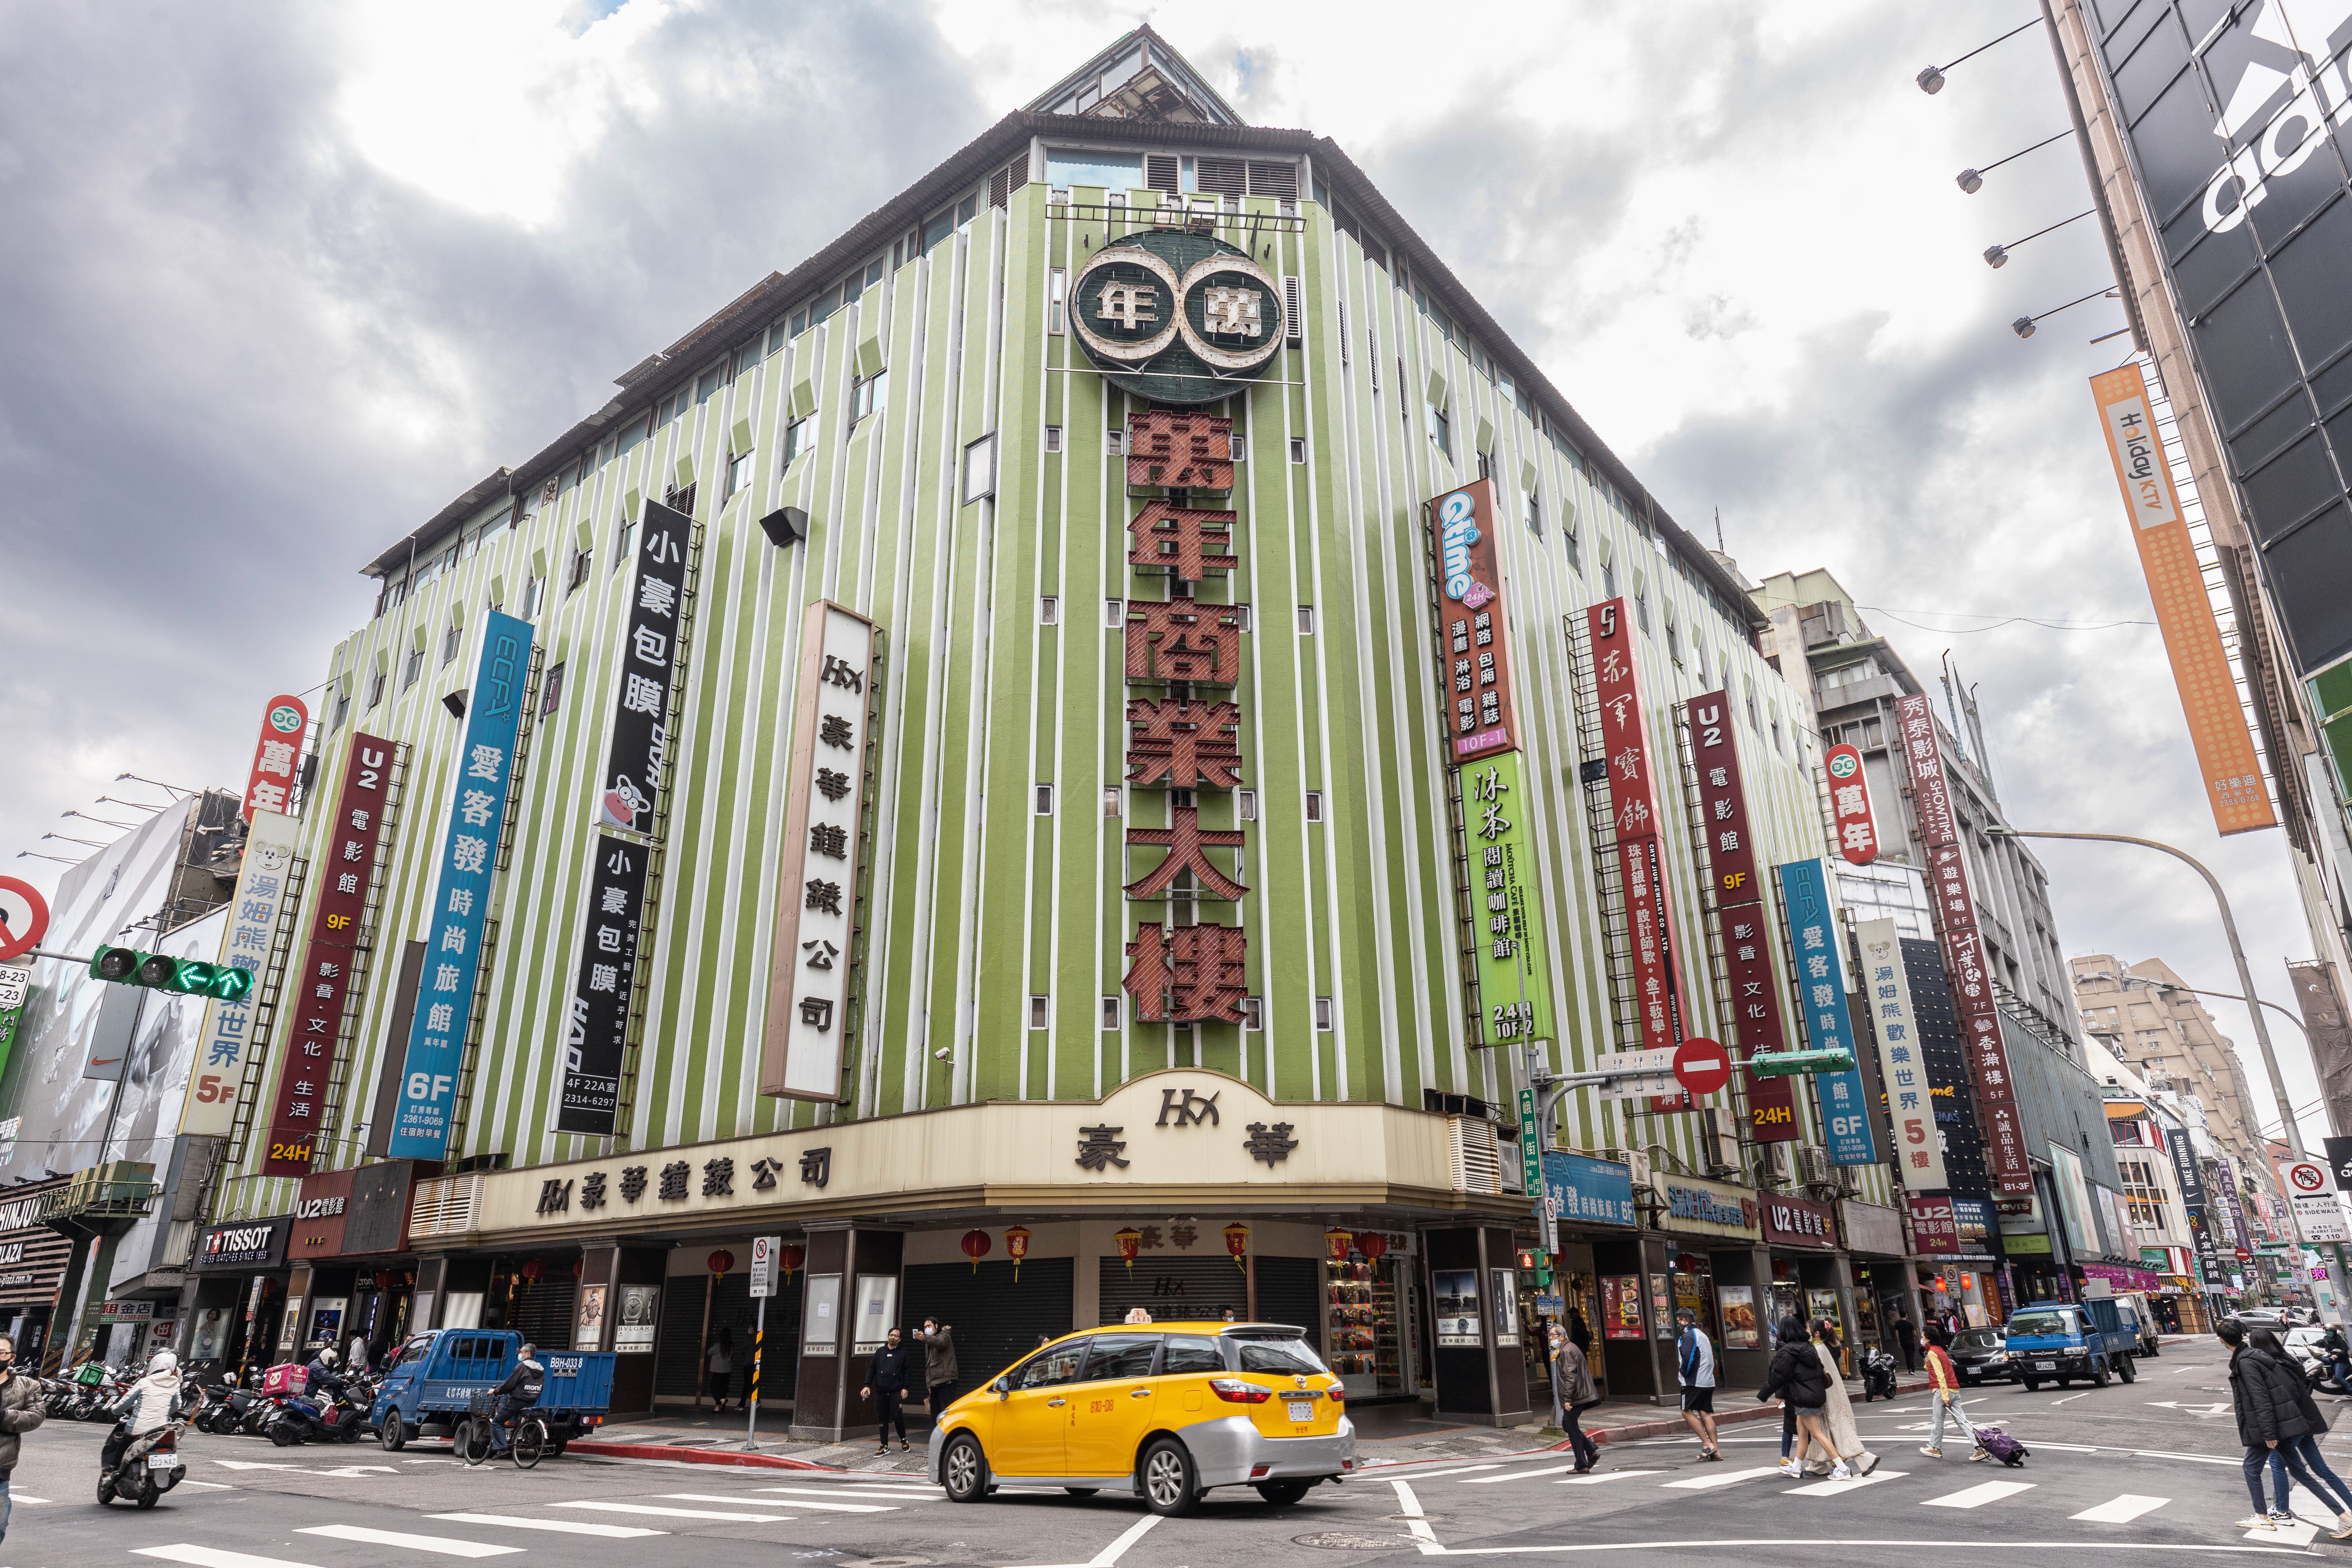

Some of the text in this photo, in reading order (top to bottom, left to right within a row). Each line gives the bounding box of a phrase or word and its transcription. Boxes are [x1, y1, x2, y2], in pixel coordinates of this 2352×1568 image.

[2120, 413, 2163, 510] Holiday KTV
[1466, 591, 1484, 602] 24H
[623, 529, 680, 719] 小豪包膜
[1451, 620, 1475, 732] 漫畫 淋浴 電影
[1475, 612, 1499, 725] 網路 包廂 雜誌
[1122, 410, 1250, 1025] 萬年商業大樓
[1698, 705, 1723, 748] U2
[1462, 731, 1502, 752] 10F-1
[1903, 697, 1939, 780] 秀泰影城
[249, 739, 296, 814] 萬年
[358, 747, 384, 790] U2
[2214, 774, 2257, 791] 好樂迪
[2219, 794, 2260, 807] 2388-0768
[2221, 788, 2254, 799] 西寧店
[1709, 766, 1739, 852] 電影館
[1835, 785, 1874, 852] 萬年
[1923, 793, 1938, 834] CINEMAS
[1929, 780, 1953, 842] SHOWTIME
[337, 810, 369, 894] 電影館
[426, 744, 503, 1033] 愛客發時尚旅館
[799, 714, 854, 1033] 豪華鐘錶公司
[1649, 844, 1659, 862] CHYH
[1654, 884, 1664, 915] JEWELRY
[1724, 873, 1746, 890] 9F
[1483, 845, 1513, 960] 閱讀咖啡館
[1943, 867, 1965, 912] 遊樂場
[326, 914, 350, 930] 9F
[589, 850, 631, 993] 小豪包膜
[1493, 1001, 1531, 1022] 24H
[424, 1037, 448, 1048] 萬年館
[1874, 967, 1920, 1111] 湯姆熊歡樂世界
[1978, 1036, 2004, 1085] 香滿樓
[196, 1075, 235, 1104] 5F
[407, 1073, 452, 1101] 6F
[564, 1093, 614, 1107] 2314-6297
[566, 1078, 616, 1093] 4F 22A室
[403, 1115, 443, 1126] 2361-9069
[410, 1105, 440, 1116] 訂房專線
[1754, 1107, 1791, 1126] 24H
[400, 1126, 441, 1139] 住宿附早餐
[1522, 1101, 1536, 1156] 峨眉街
[1832, 1116, 1862, 1136] 6F
[271, 1144, 310, 1162] 24H
[1838, 1144, 1866, 1153] 2361-9069
[1838, 1151, 1868, 1161] 住宿附早餐
[1904, 1118, 1930, 1169] 5樓
[1998, 1121, 2019, 1170] 誠品生活
[2174, 1135, 2195, 1186] NIKE RUNNING
[580, 1147, 832, 1209] 豪華鐘錶公司
[2004, 1182, 2030, 1191] B1-3F
[2218, 1159, 2241, 1216] 西門星辰大飯店
[2298, 1170, 2317, 1185] 停
[1621, 1200, 1633, 1221] 6F
[1740, 1197, 1759, 1229] 5F
[1771, 1205, 1792, 1231] U2
[1791, 1208, 1823, 1236] 電影館
[1912, 1206, 1951, 1220] U2
[222, 1226, 273, 1252] TISSOT
[1914, 1220, 1954, 1234] 電影館
[200, 1250, 267, 1263] SWISS WATCHES SINCE 1853
[758, 1244, 765, 1254] 停
[1929, 1238, 1947, 1247] 24H
